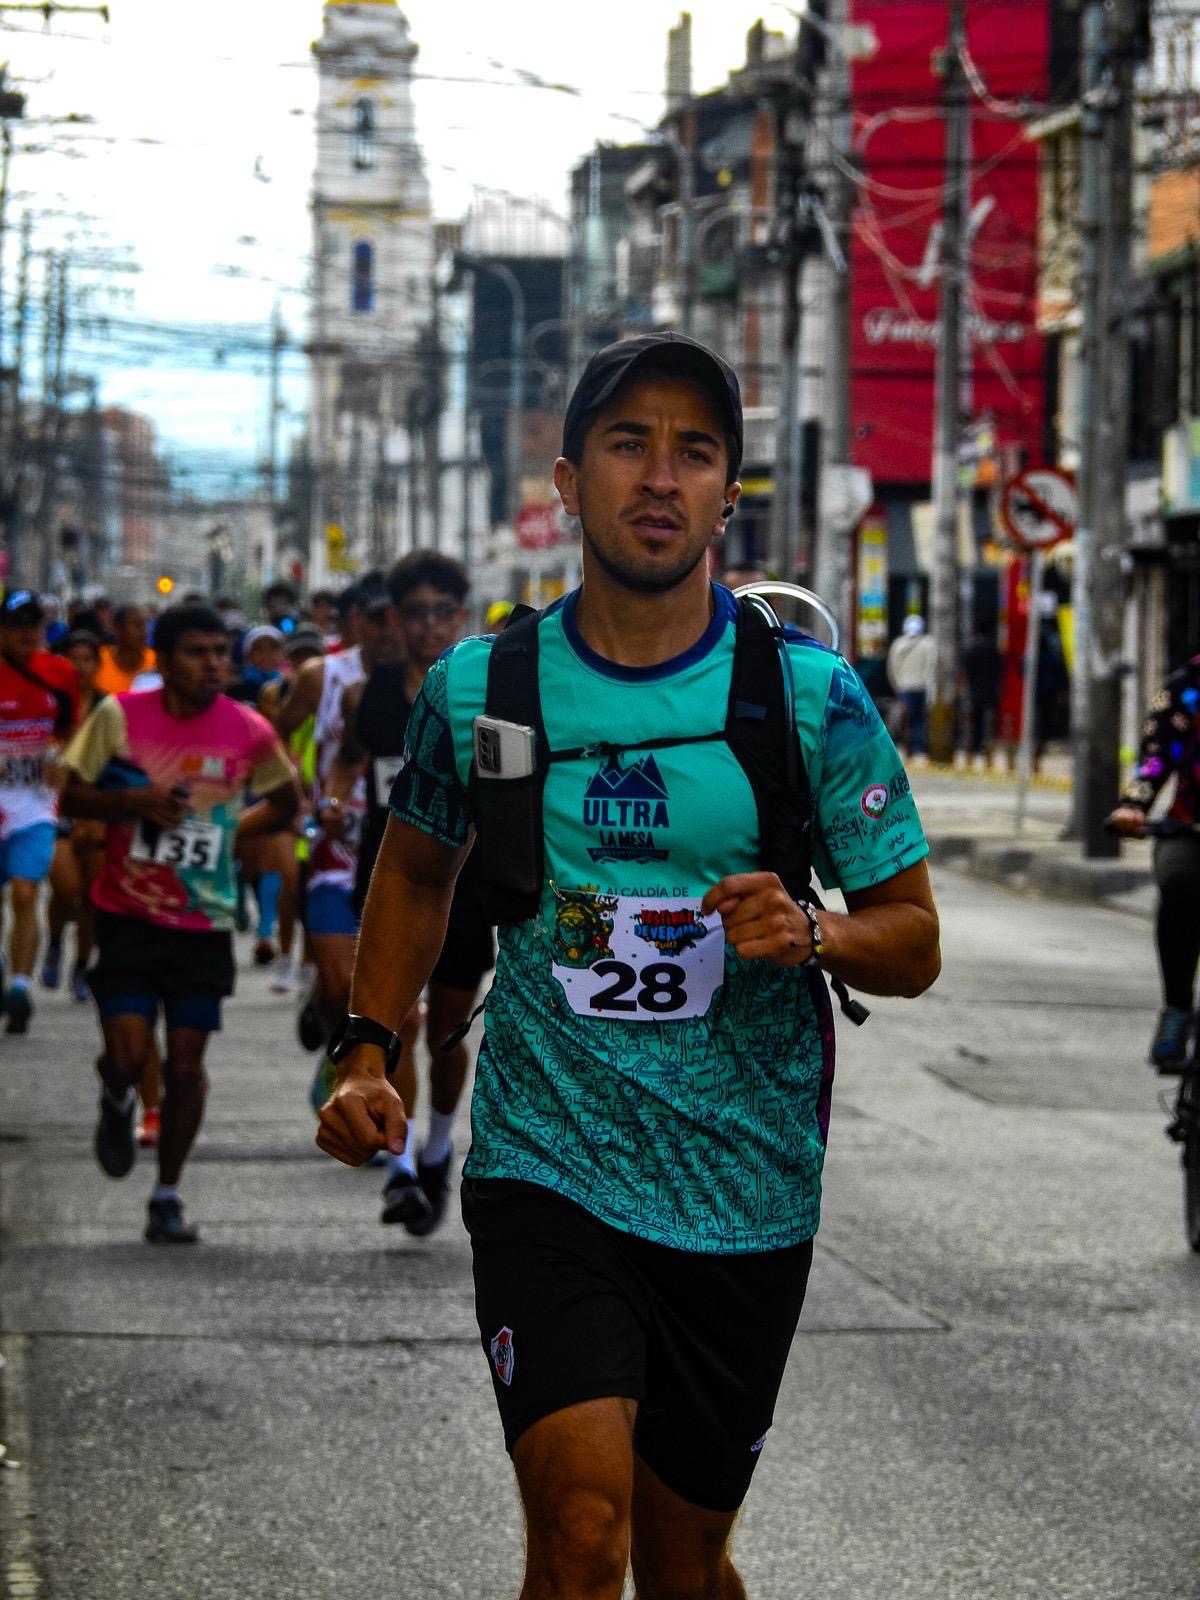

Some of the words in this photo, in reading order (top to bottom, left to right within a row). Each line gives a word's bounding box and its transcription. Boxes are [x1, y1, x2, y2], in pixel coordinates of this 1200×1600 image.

[583, 800, 670, 828] ULTRA
[599, 830, 616, 848] LA
[618, 830, 655, 849] MESA
[672, 886, 689, 898] DE
[634, 924, 649, 938] DE
[589, 960, 688, 1013] 28
